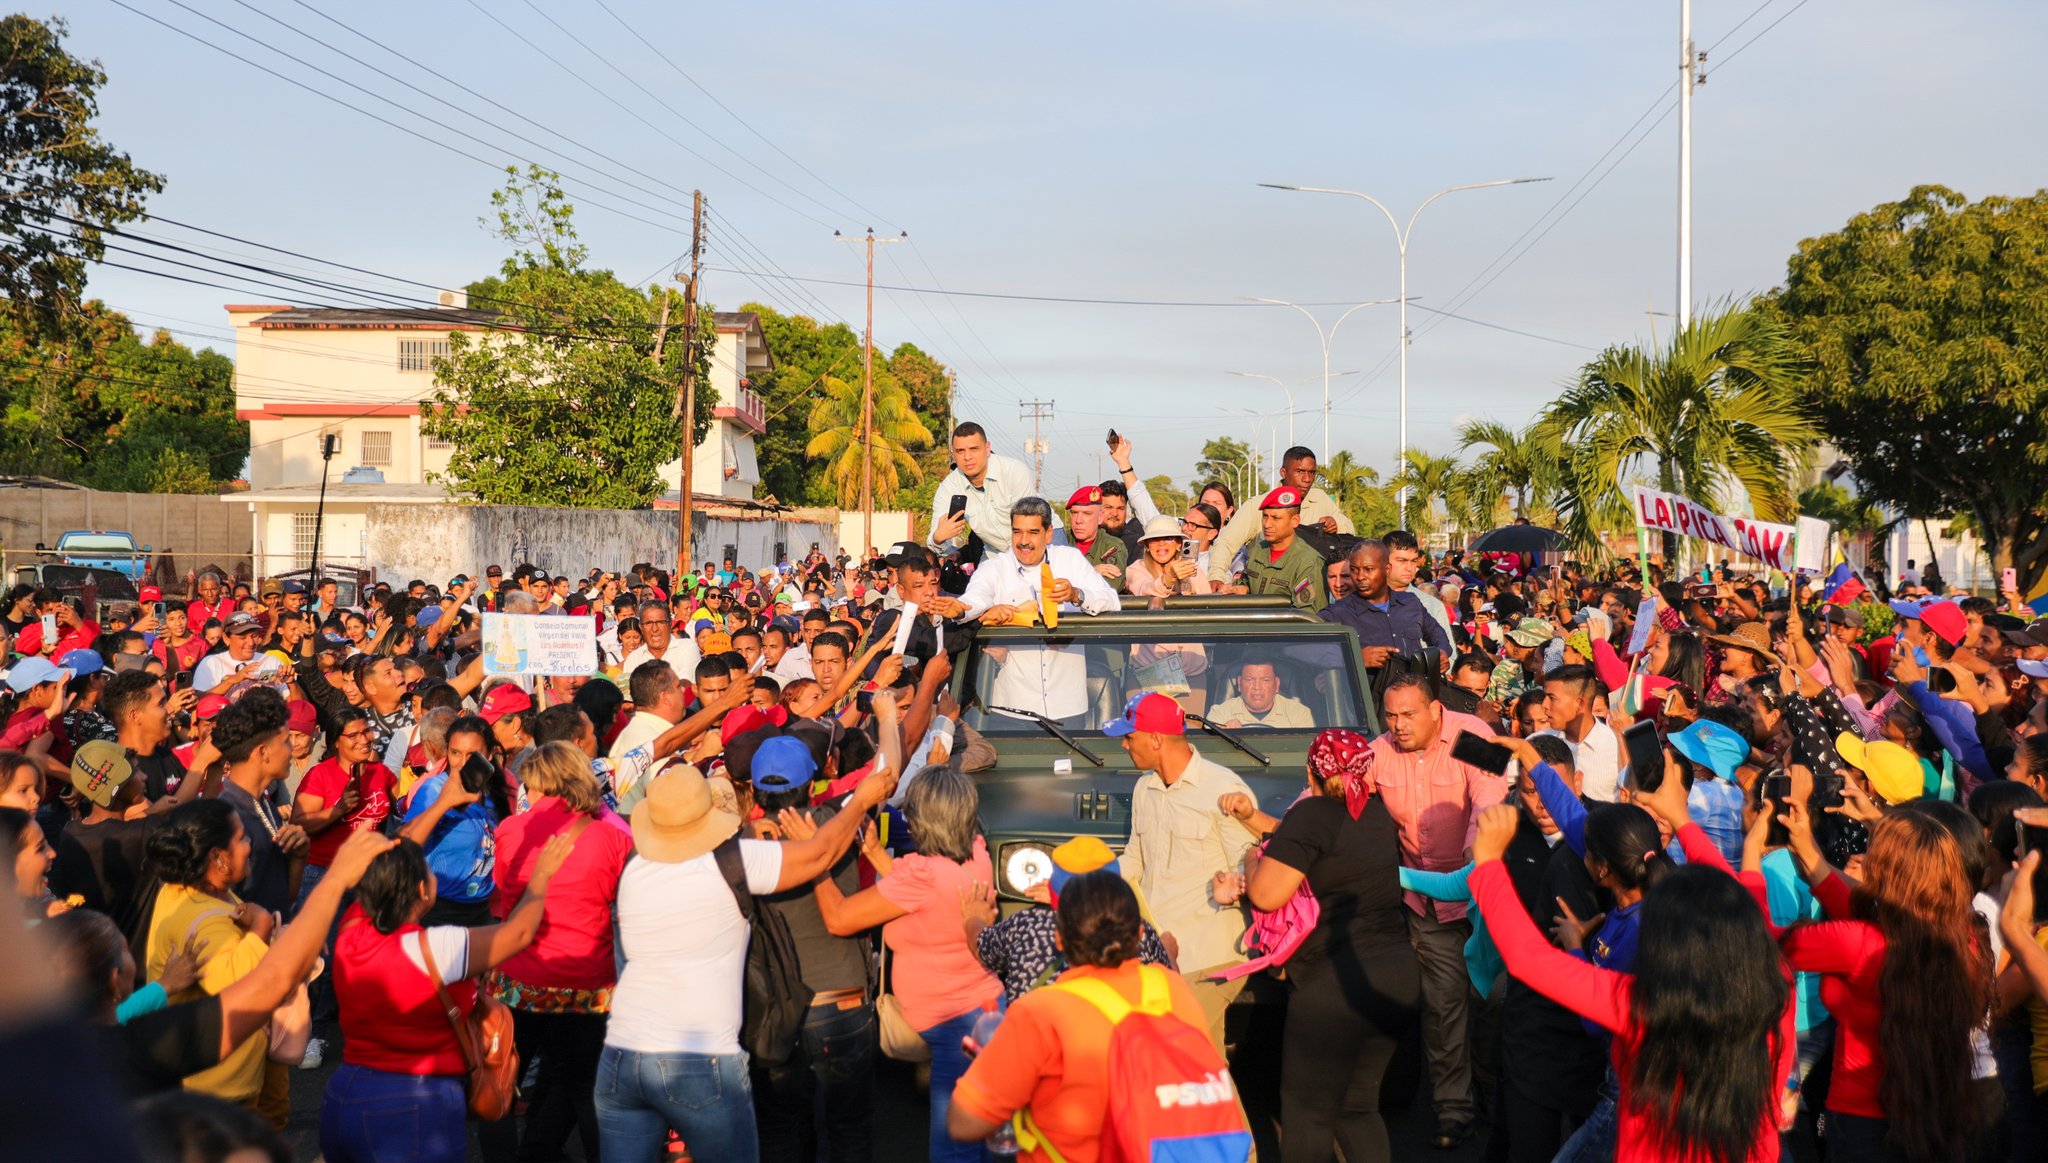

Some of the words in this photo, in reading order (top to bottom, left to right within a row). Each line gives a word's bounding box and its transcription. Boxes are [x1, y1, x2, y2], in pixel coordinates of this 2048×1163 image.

[1639, 494, 1672, 529] LA
[534, 622, 560, 630] Consejo
[561, 622, 589, 630] Comunal
[538, 632, 560, 640] Virgen
[548, 651, 577, 659] PRESENTE
